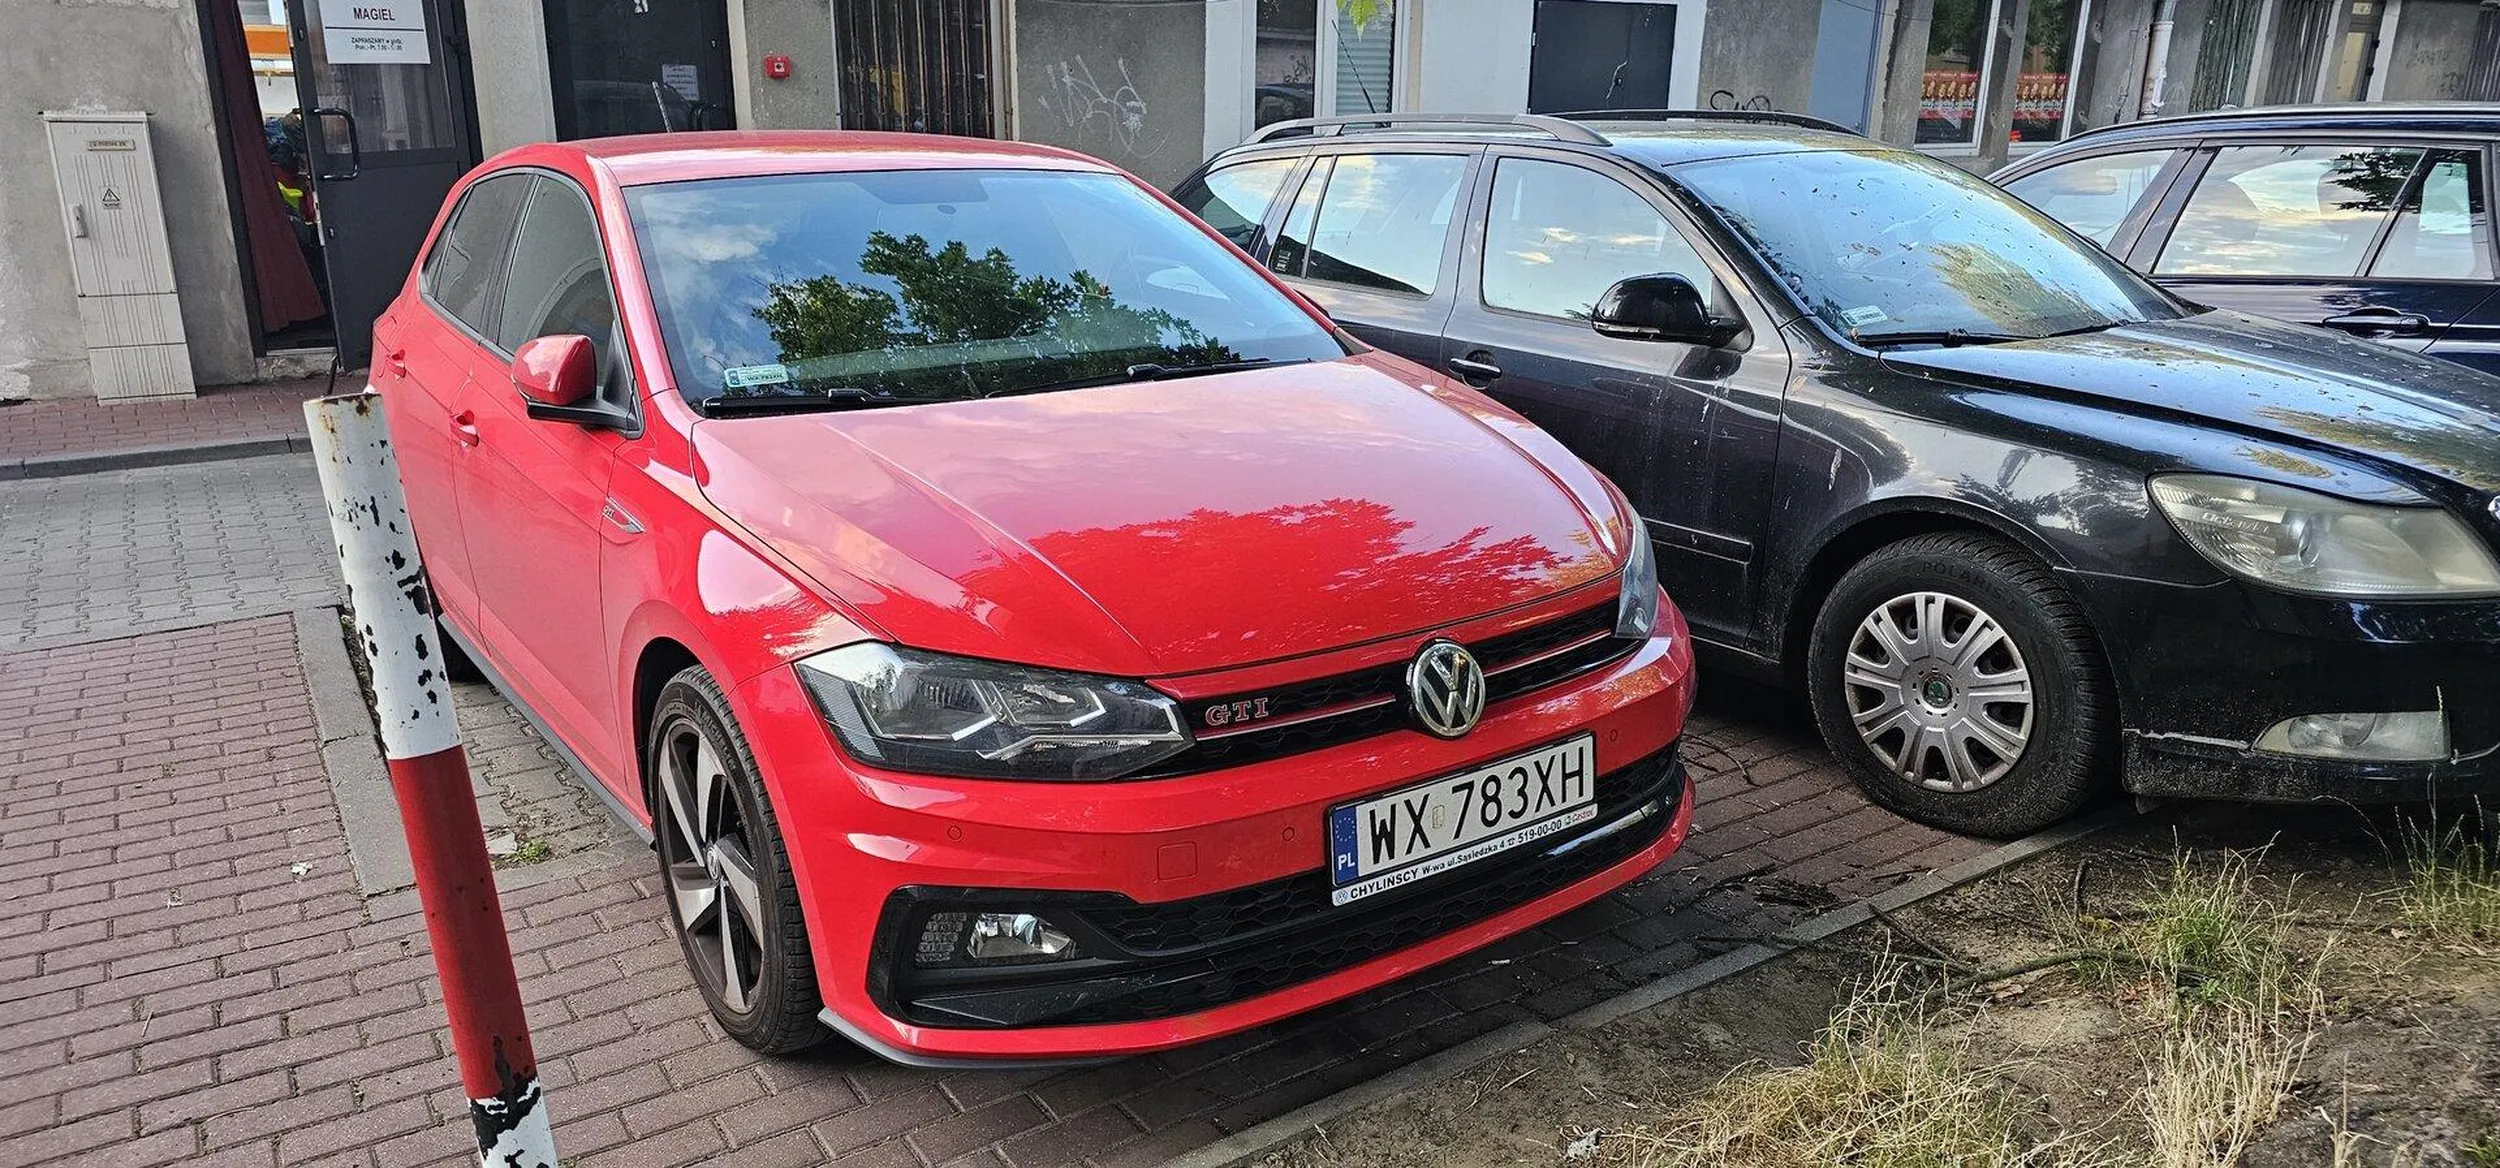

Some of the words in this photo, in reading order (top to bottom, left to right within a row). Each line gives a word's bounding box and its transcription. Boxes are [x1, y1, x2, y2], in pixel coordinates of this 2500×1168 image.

[353, 7, 396, 21] MAGIEL
[1922, 561, 2003, 599] POLARIS
[1204, 697, 1269, 727] GTI
[1369, 793, 1431, 865] WX
[1451, 746, 1584, 841] 783XH
[1337, 853, 1355, 871] PL
[1350, 868, 1419, 899] CHYLIŃSCY
[1422, 862, 1445, 875] W-wa
[1500, 840, 1505, 848] 4
[1517, 819, 1562, 844] 519-00-00
